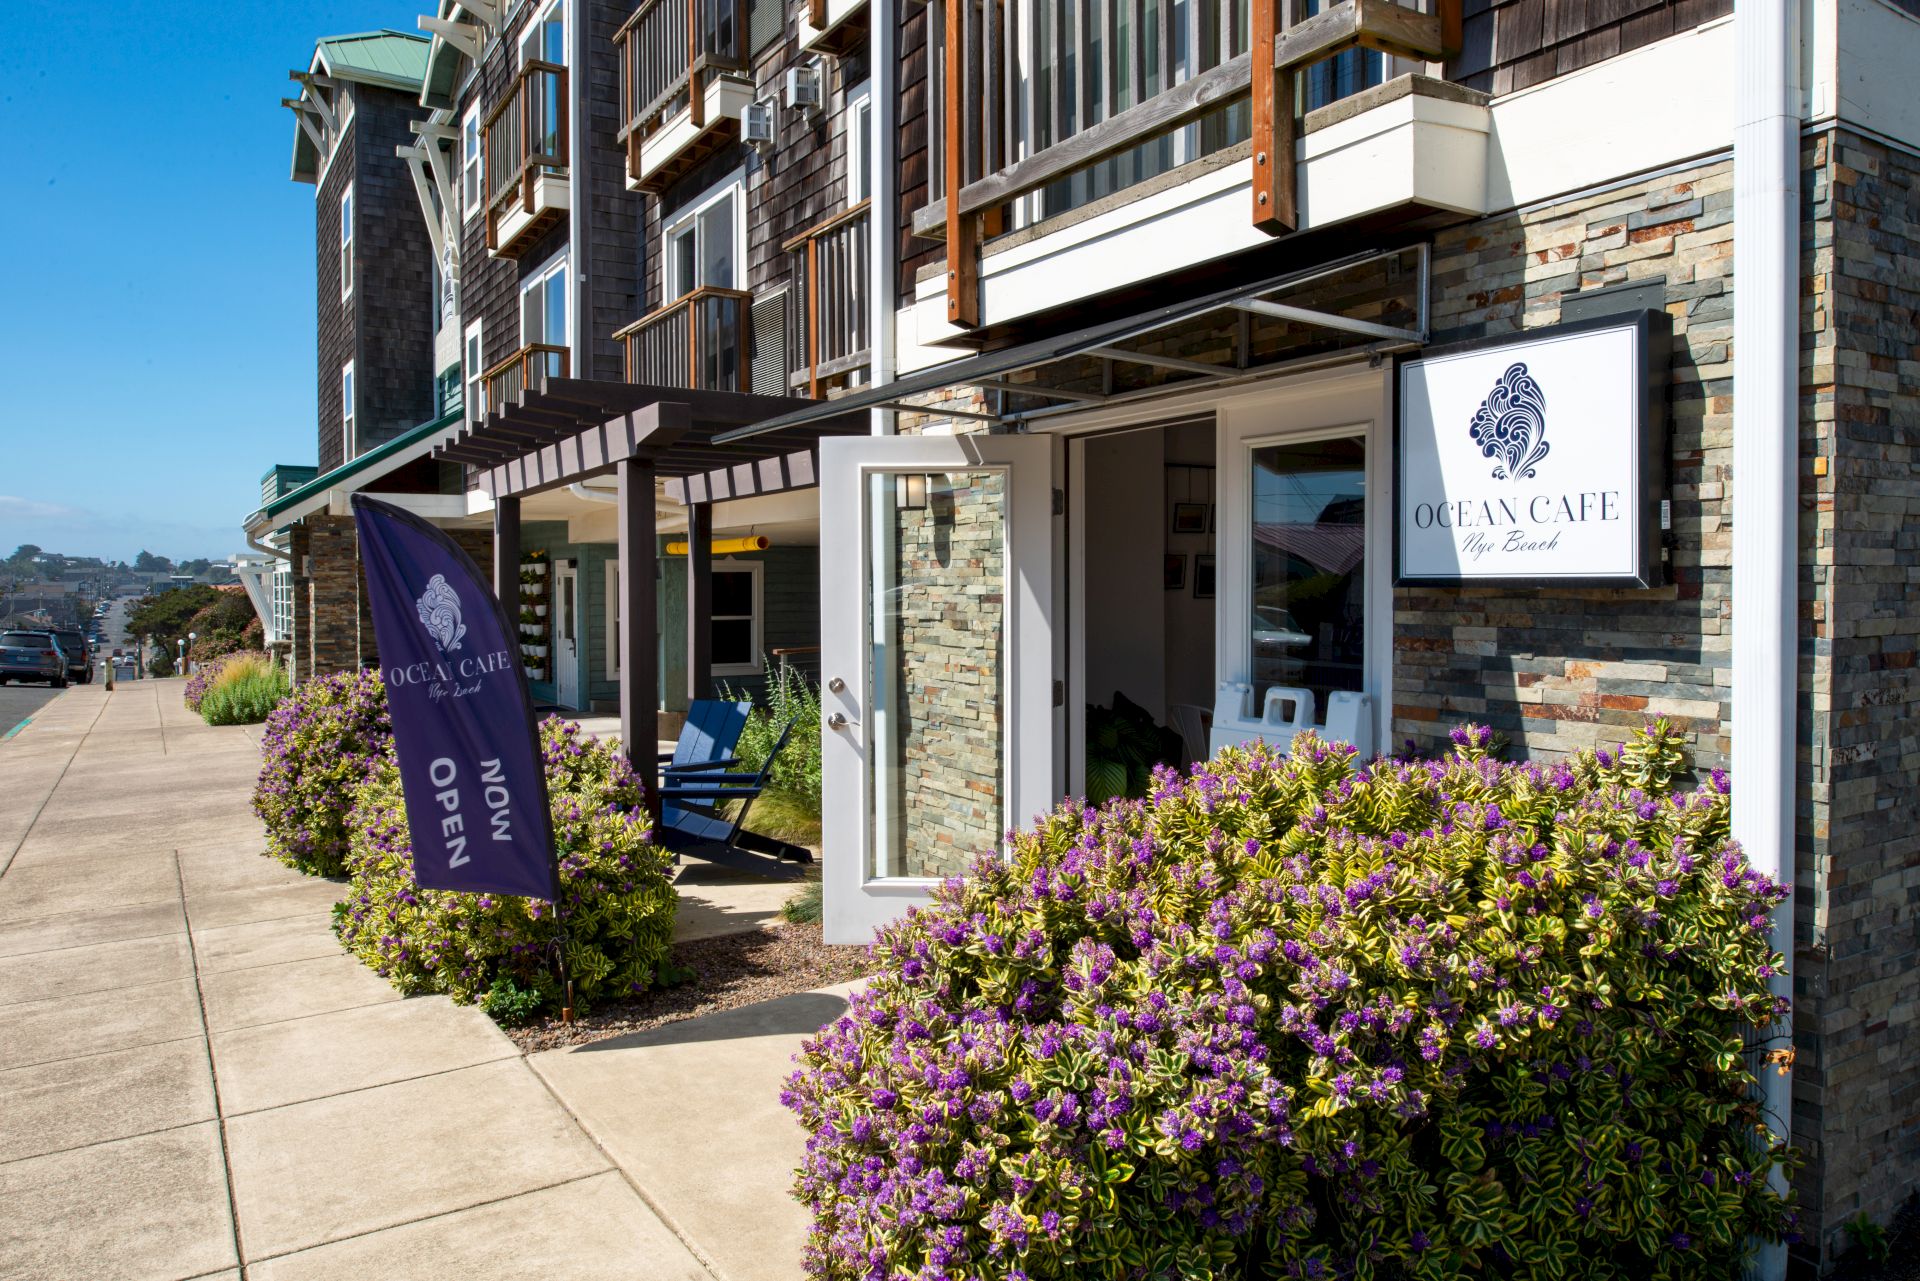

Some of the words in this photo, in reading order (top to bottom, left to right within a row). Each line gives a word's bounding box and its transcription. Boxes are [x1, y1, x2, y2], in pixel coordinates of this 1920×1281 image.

[1415, 497, 1518, 529] OCEAN
[1529, 491, 1619, 524] CAFE
[1461, 532, 1495, 561] Nye
[1501, 530, 1562, 552] Beach
[460, 650, 511, 678] CAFE
[453, 679, 482, 697] Bach
[429, 757, 471, 869] OPEN
[480, 758, 512, 840] NOW
